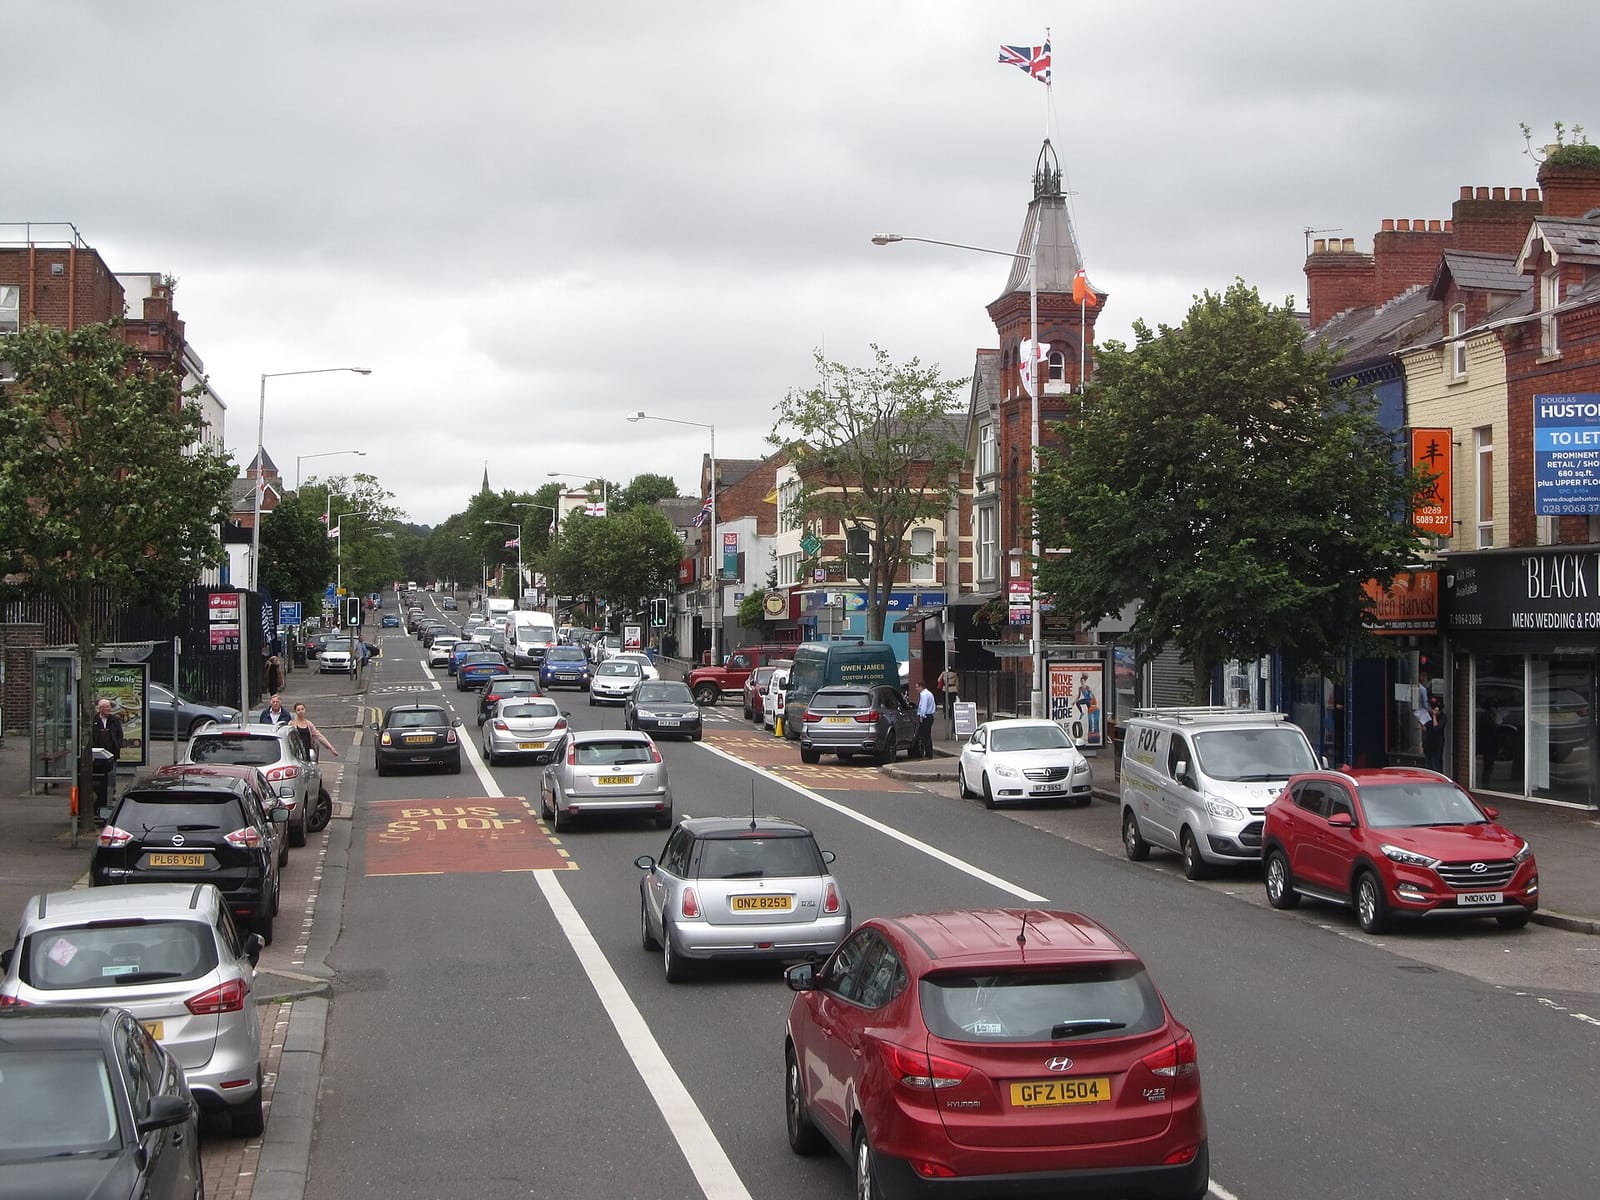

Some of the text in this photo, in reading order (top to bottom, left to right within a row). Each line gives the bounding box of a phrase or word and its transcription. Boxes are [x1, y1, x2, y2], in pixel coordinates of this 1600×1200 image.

[1541, 404, 1600, 418] HUSTO
[1550, 431, 1600, 445] TO LET
[1552, 451, 1599, 459] PROMINENT
[1576, 460, 1581, 469] /
[1542, 505, 1560, 513] 028
[1562, 504, 1586, 513] 9068
[1416, 516, 1448, 524] 5089 227
[1528, 555, 1587, 598] BLACK
[1398, 593, 1434, 617] Harvest
[1512, 613, 1534, 628] MENS
[1535, 612, 1574, 629] WEDDING
[1577, 612, 1583, 629] &
[114, 675, 135, 683] Deals
[1052, 673, 1073, 685] MOVE
[1052, 686, 1073, 696] MORE
[1052, 697, 1068, 708] WIN
[1052, 708, 1072, 720] MORE
[1138, 728, 1160, 753] FOX
[401, 806, 498, 818] BUS
[388, 818, 522, 833] STOP
[154, 855, 200, 865] PL66 VSN
[737, 898, 787, 908] ONZ 8253
[1022, 1081, 1099, 1101] GFZ 1504
